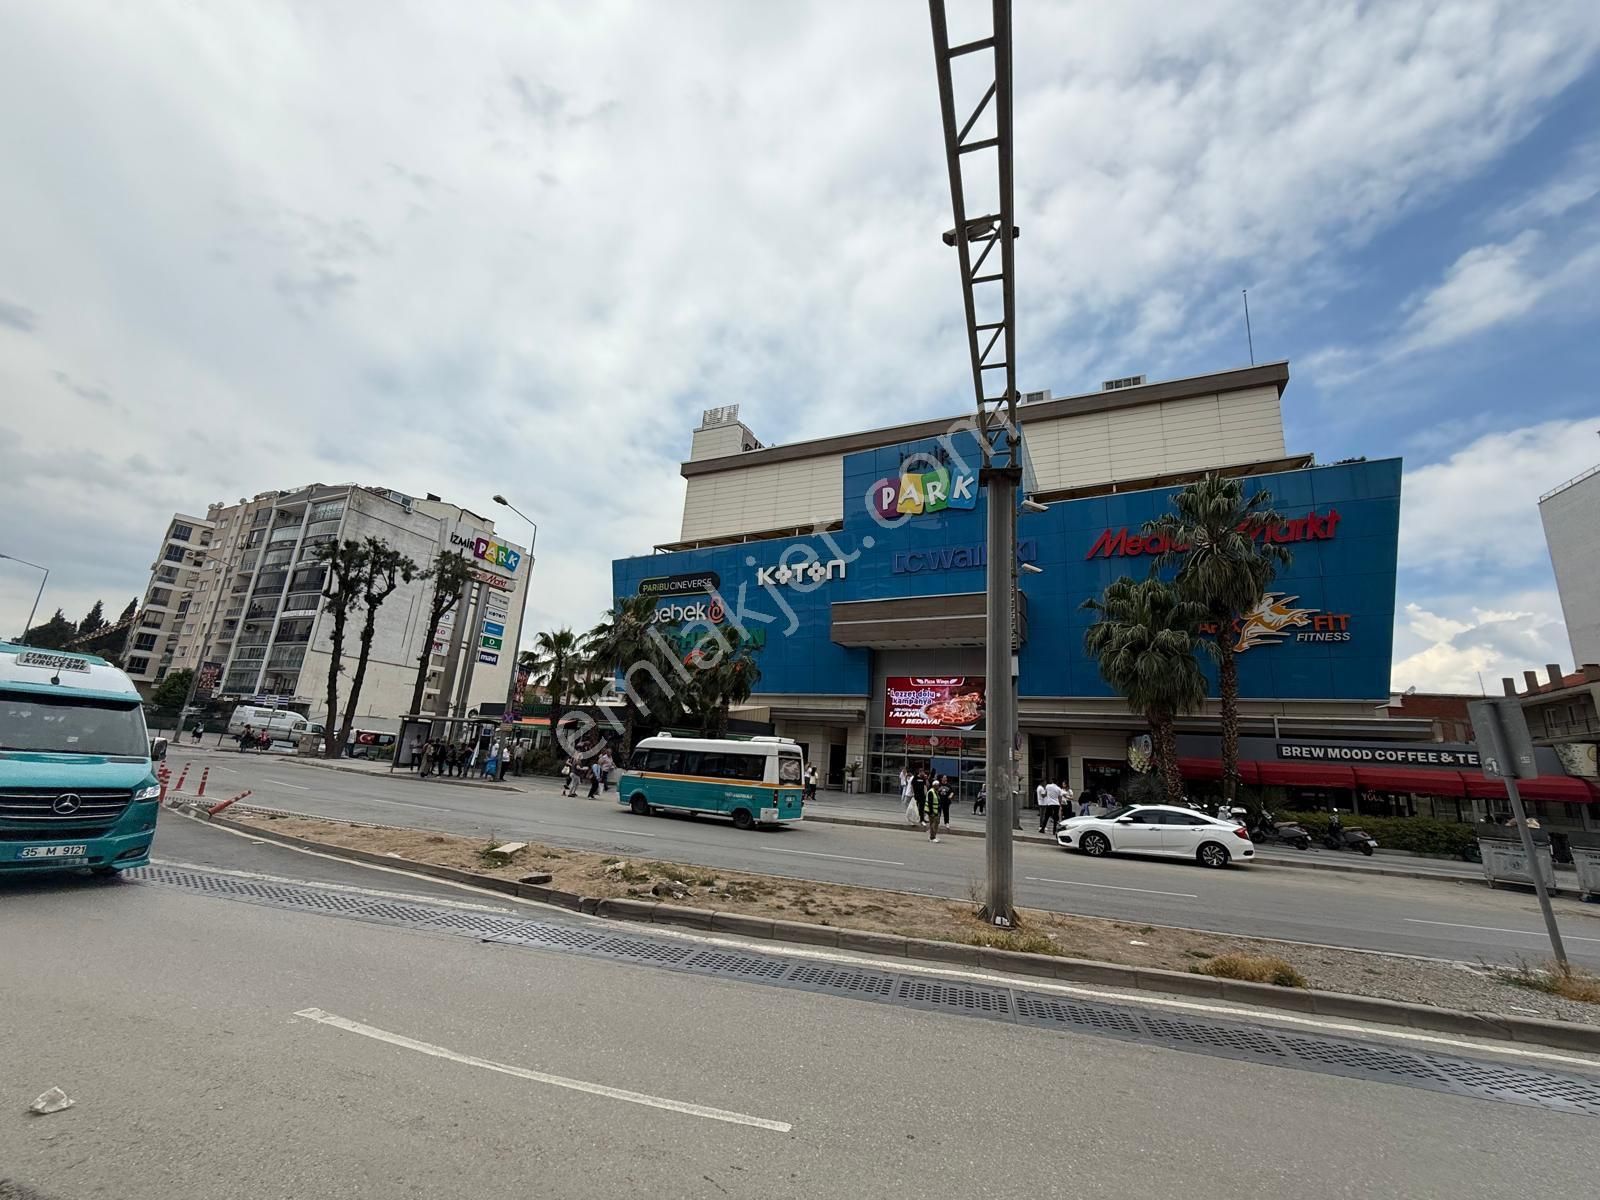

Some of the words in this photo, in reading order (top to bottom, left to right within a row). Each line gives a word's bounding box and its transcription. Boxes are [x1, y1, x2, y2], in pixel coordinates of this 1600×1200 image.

[881, 475, 975, 511] PARK
[477, 542, 518, 568] PARK
[757, 559, 846, 586] KOTON
[669, 578, 713, 591] CINEVERSE
[1297, 632, 1350, 642] FITNESS
[891, 690, 917, 699] Lezzet
[1282, 746, 1326, 758] BREW
[1327, 748, 1372, 760] MOOD
[1374, 750, 1438, 763] COFFEE
[1440, 752, 1453, 763] &
[1456, 753, 1481, 765] TE
[22, 848, 38, 857] 35
[46, 848, 57, 856] M
[63, 846, 85, 856] 9121
